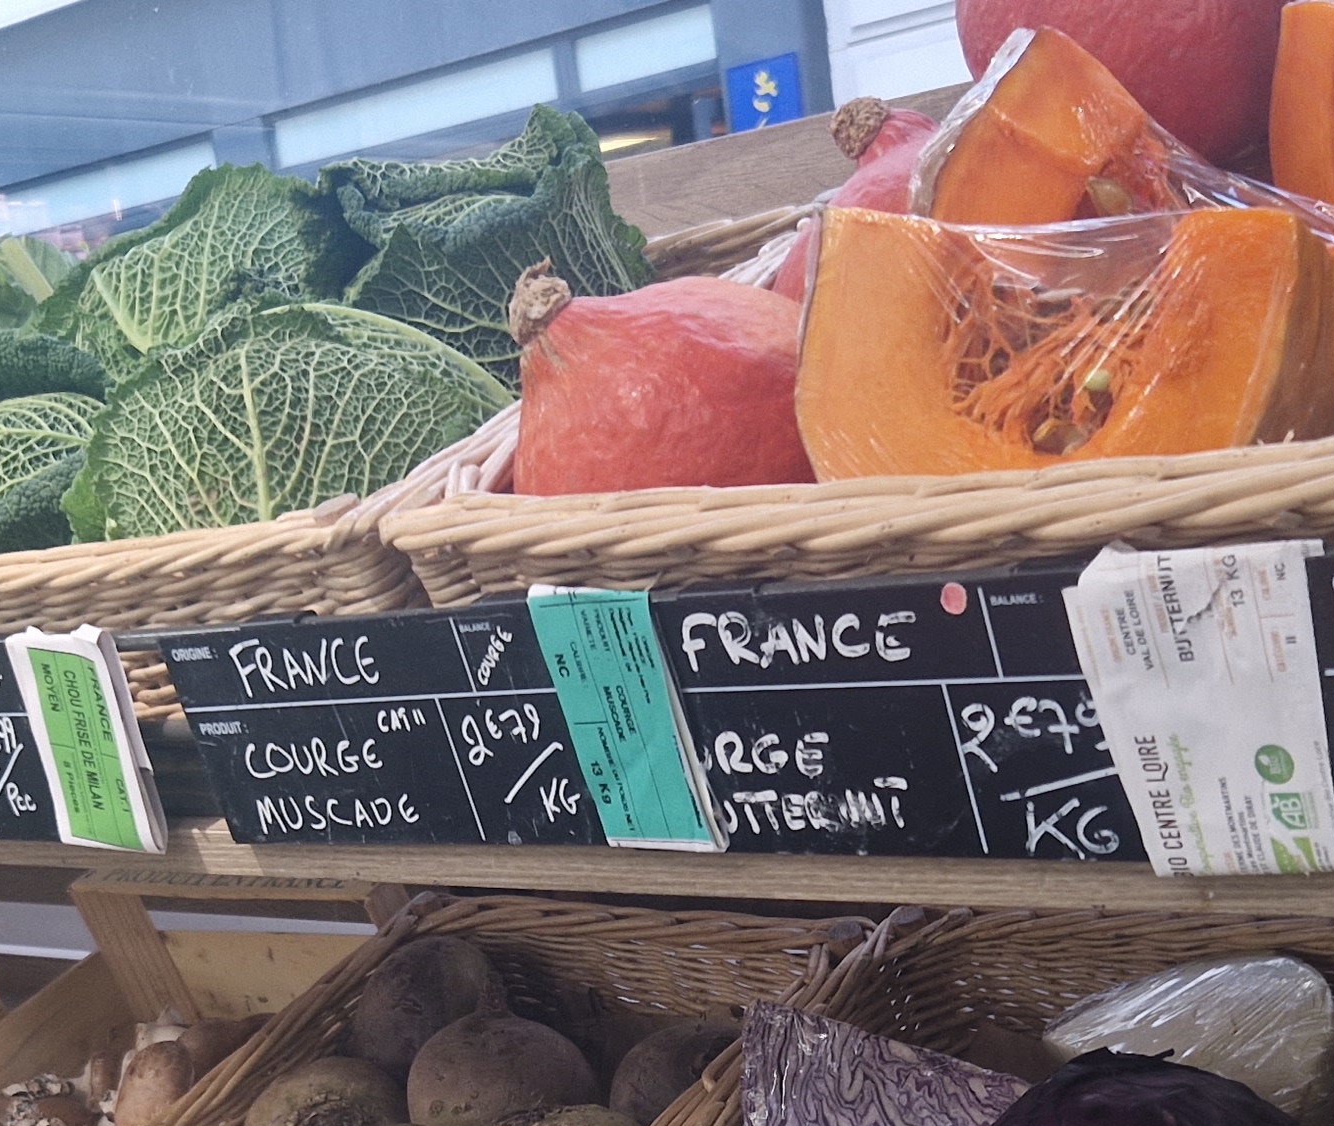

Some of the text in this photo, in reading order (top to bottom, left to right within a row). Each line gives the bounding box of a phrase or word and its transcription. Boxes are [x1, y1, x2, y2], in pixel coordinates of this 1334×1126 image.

[989, 593, 1037, 607] BALANCE
[1222, 554, 1246, 608] 13 KG
[1114, 606, 1136, 657] CENTRE
[1125, 589, 1143, 627] LOIRE
[170, 634, 381, 700] ORIGINE FRANCE
[477, 626, 514, 688] COURGE
[554, 653, 571, 679] NC
[680, 610, 917, 673] FRANCE
[40, 661, 61, 713] MOYEN
[87, 665, 114, 744] FRANCE
[615, 685, 638, 735] COURGE
[198, 719, 243, 736] PRODUIT
[602, 685, 627, 743] MUSCADE
[63, 669, 106, 812] CHOU FRISE DE MILAN
[243, 736, 385, 780] COURGE
[1134, 734, 1169, 782] LOIRE
[539, 777, 582, 824] KG
[589, 759, 613, 806] 13 Kg
[254, 792, 421, 836] MUSCADE
[1024, 797, 1121, 860] KG
[1148, 788, 1184, 851] CENTRE
